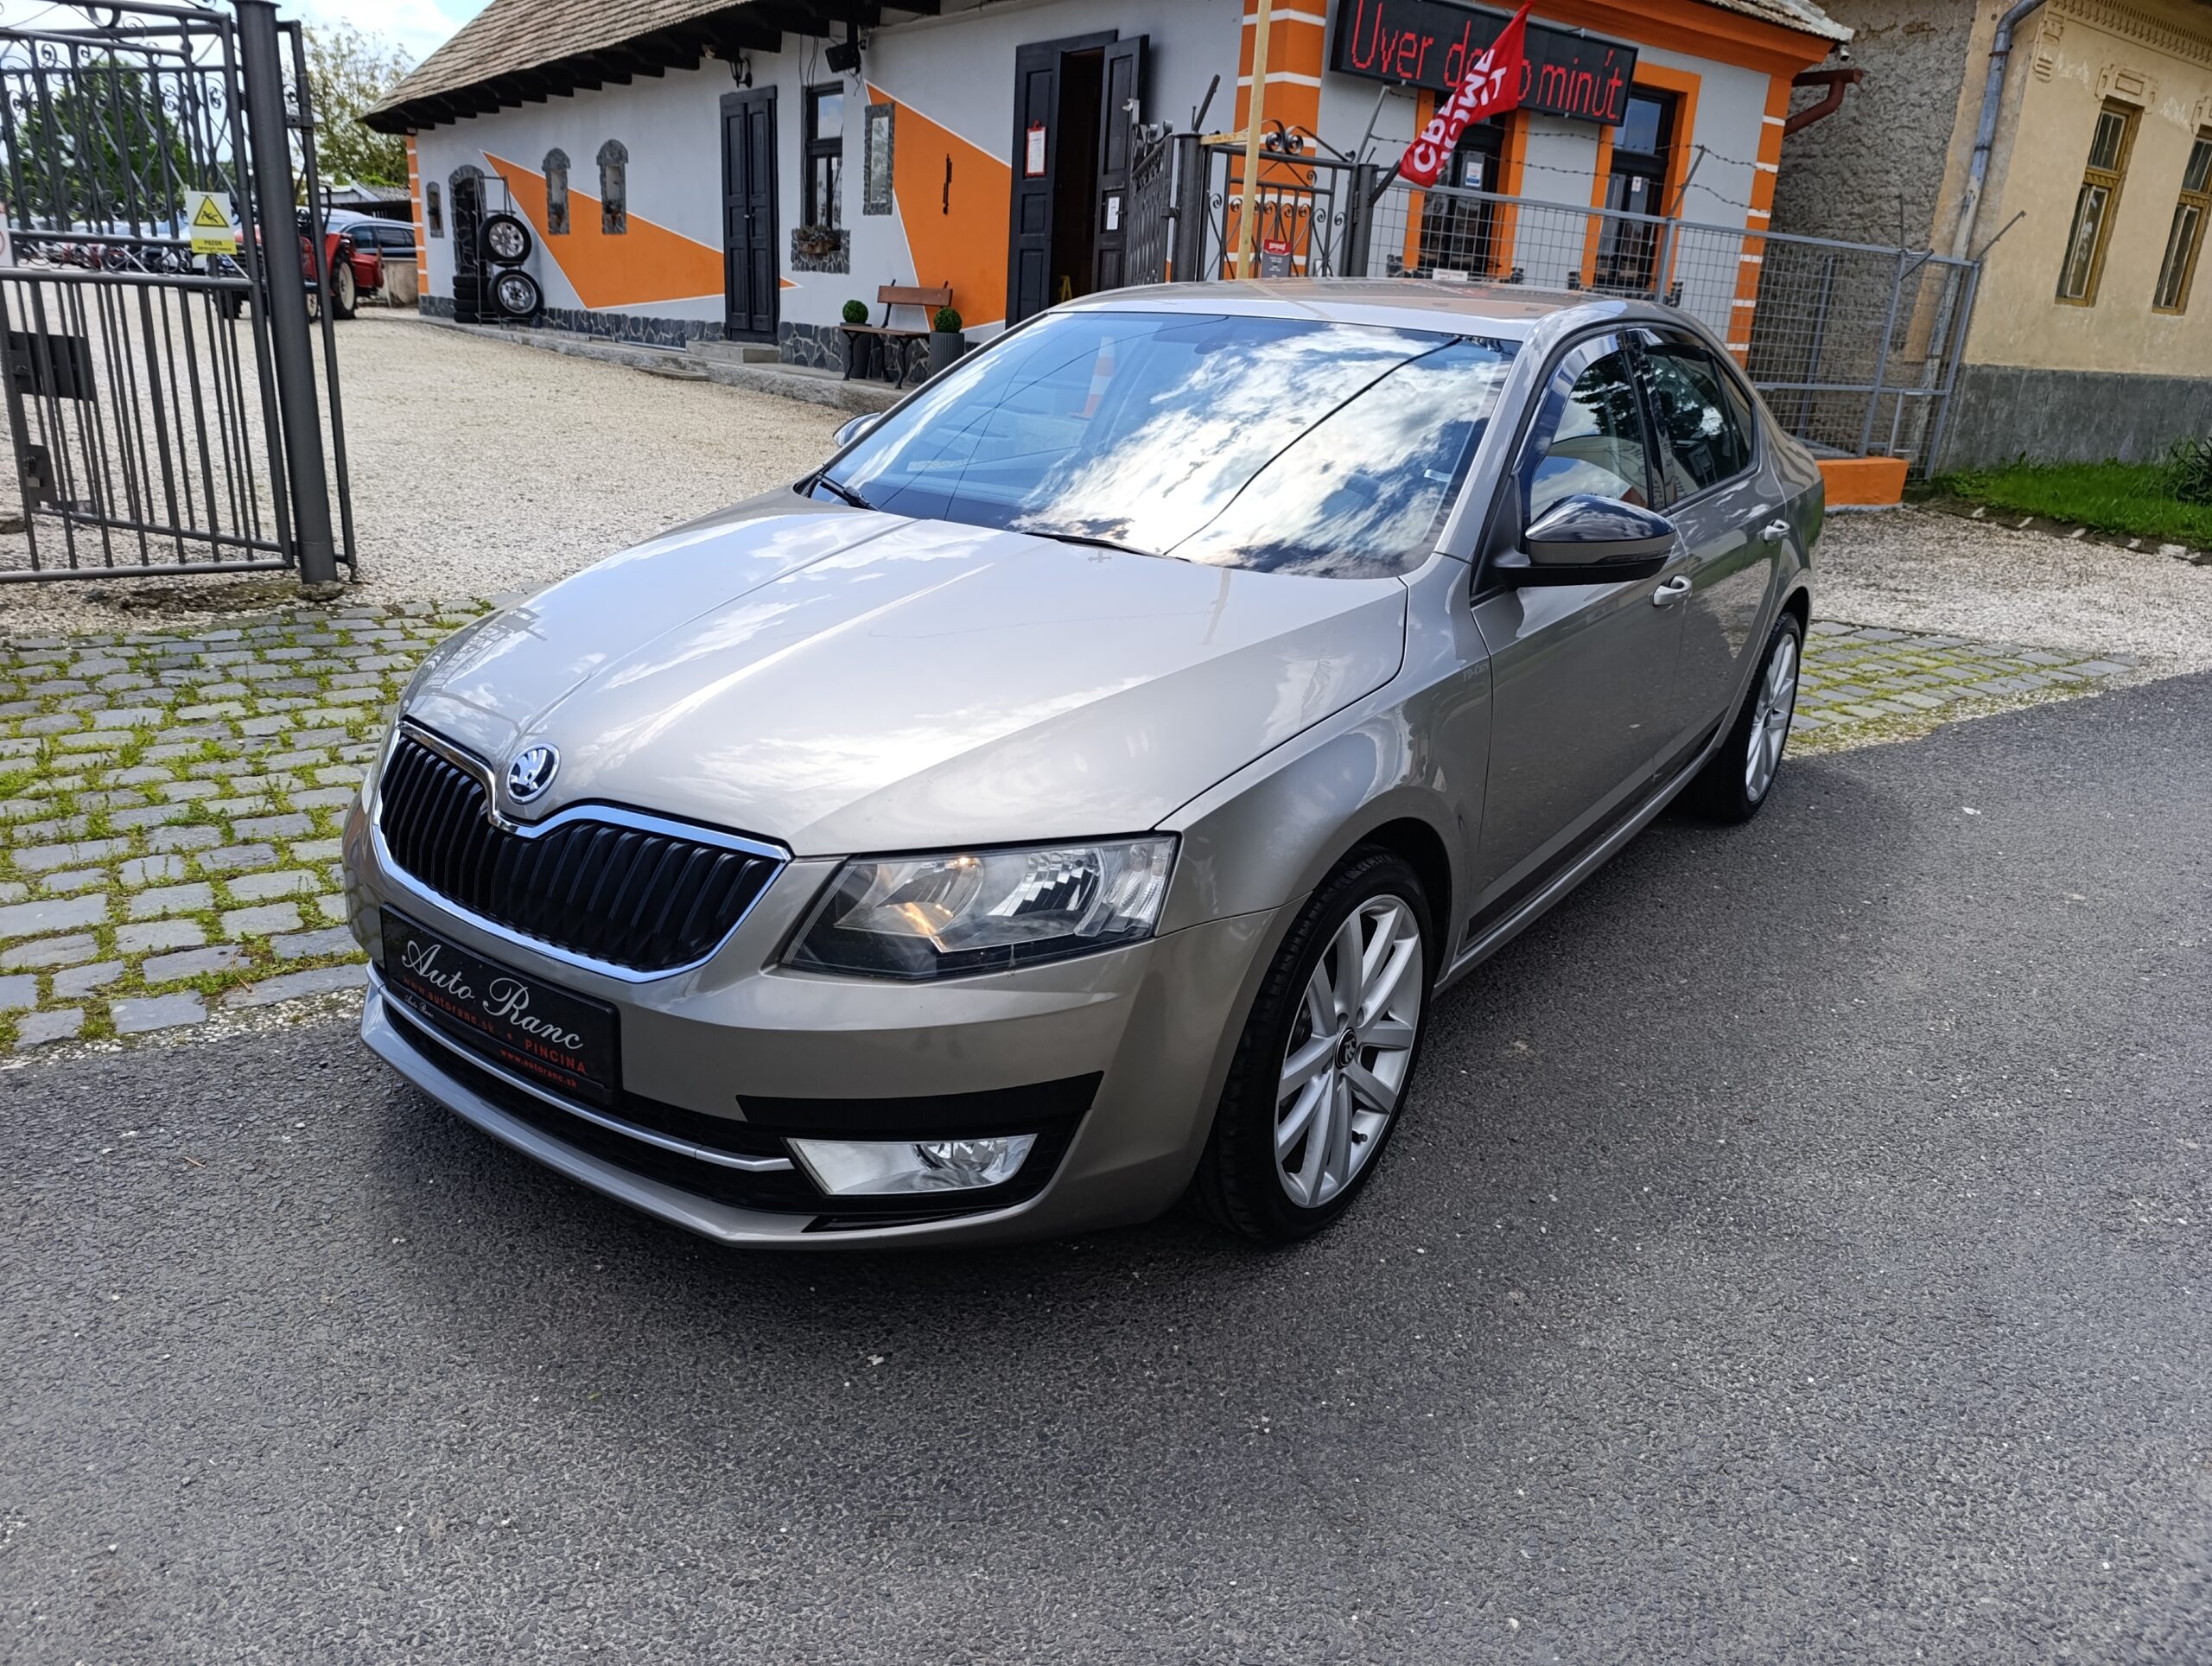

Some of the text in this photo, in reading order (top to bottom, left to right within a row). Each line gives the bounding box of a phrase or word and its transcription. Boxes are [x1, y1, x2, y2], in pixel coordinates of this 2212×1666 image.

[402, 940, 583, 1049] Auto Ranc
[403, 976, 587, 1075] www.autoranc.sk PINCINA
[499, 1049, 577, 1088] www.autoranc.sk
